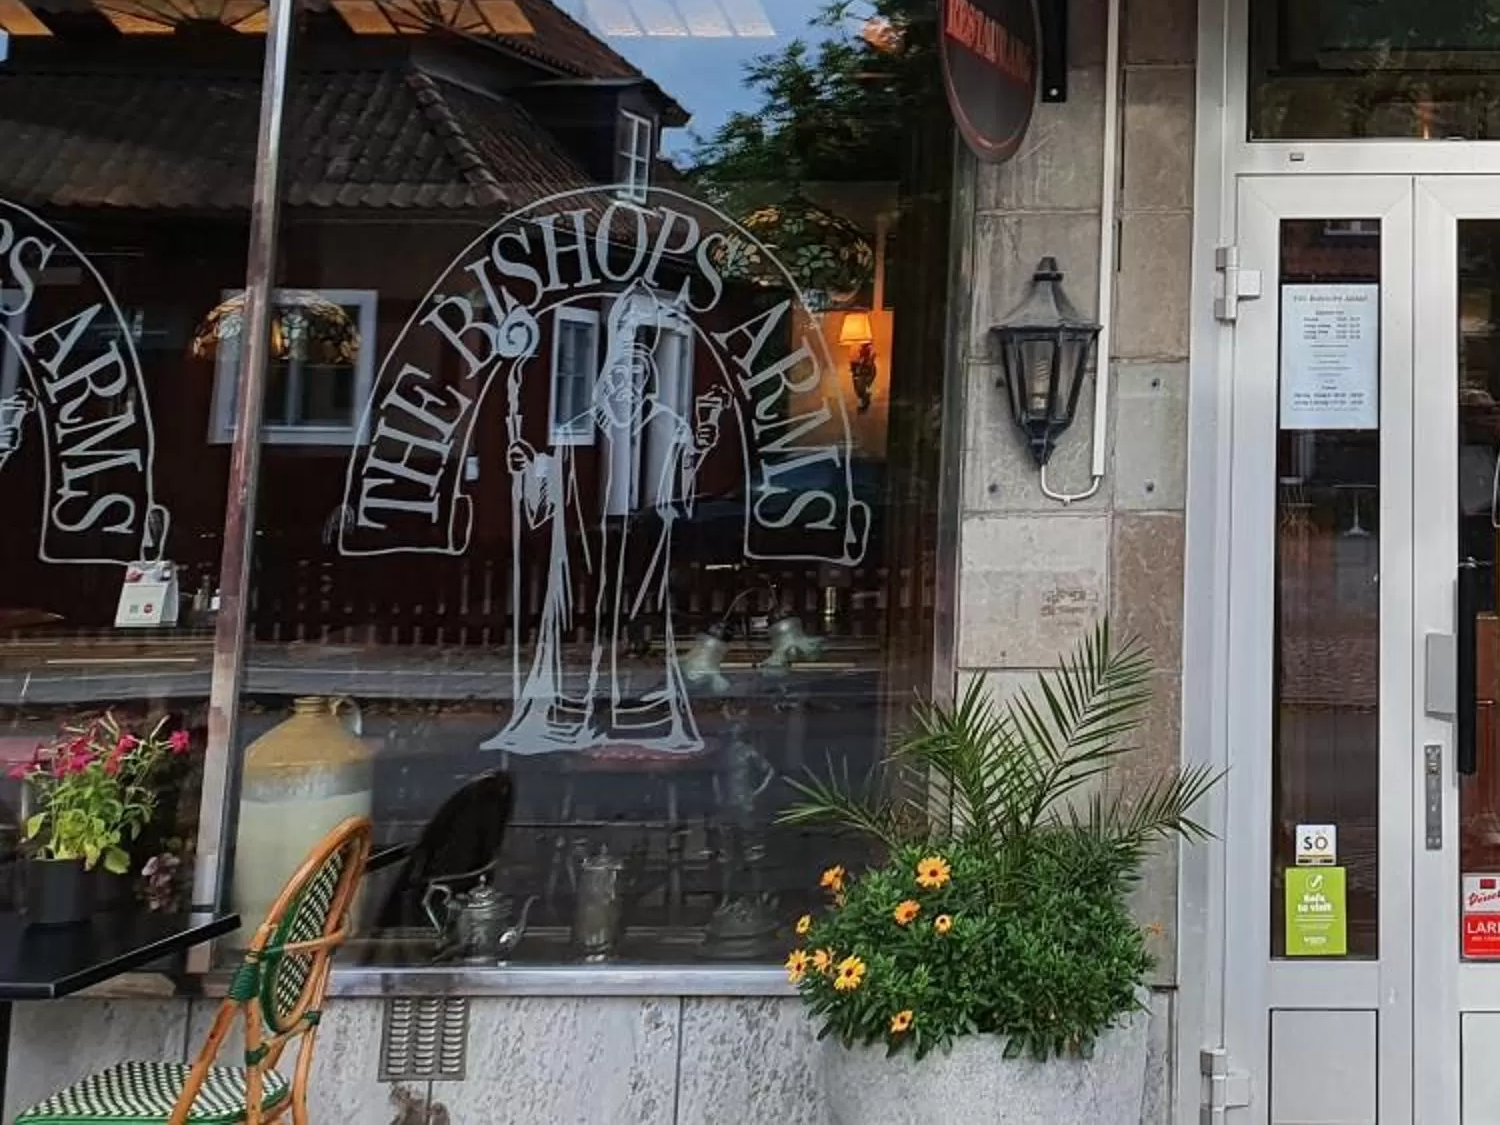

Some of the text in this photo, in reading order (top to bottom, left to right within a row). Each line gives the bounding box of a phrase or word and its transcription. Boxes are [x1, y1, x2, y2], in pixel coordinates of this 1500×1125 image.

[19, 303, 143, 535] ARMS
[357, 201, 841, 533] THE BISHOPS ARMS
